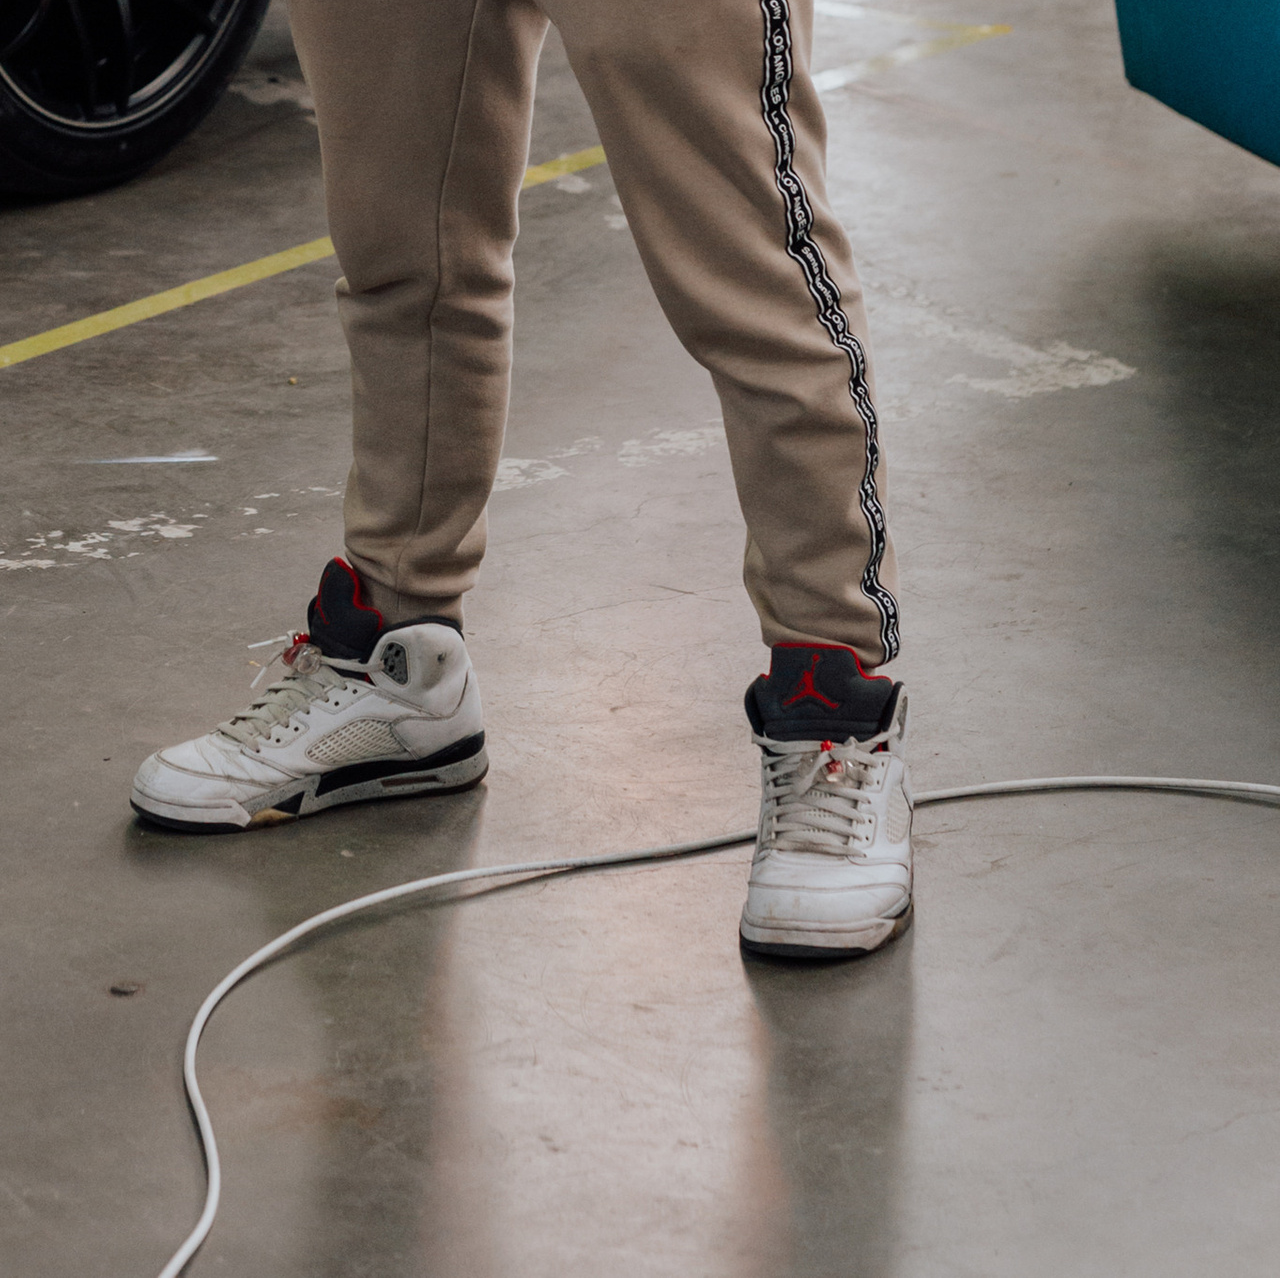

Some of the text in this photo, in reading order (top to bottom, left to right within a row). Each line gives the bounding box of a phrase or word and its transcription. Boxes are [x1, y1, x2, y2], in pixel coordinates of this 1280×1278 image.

[801, 246, 820, 275] Santa
[826, 309, 844, 332] LOS
[877, 592, 895, 615] LOS
